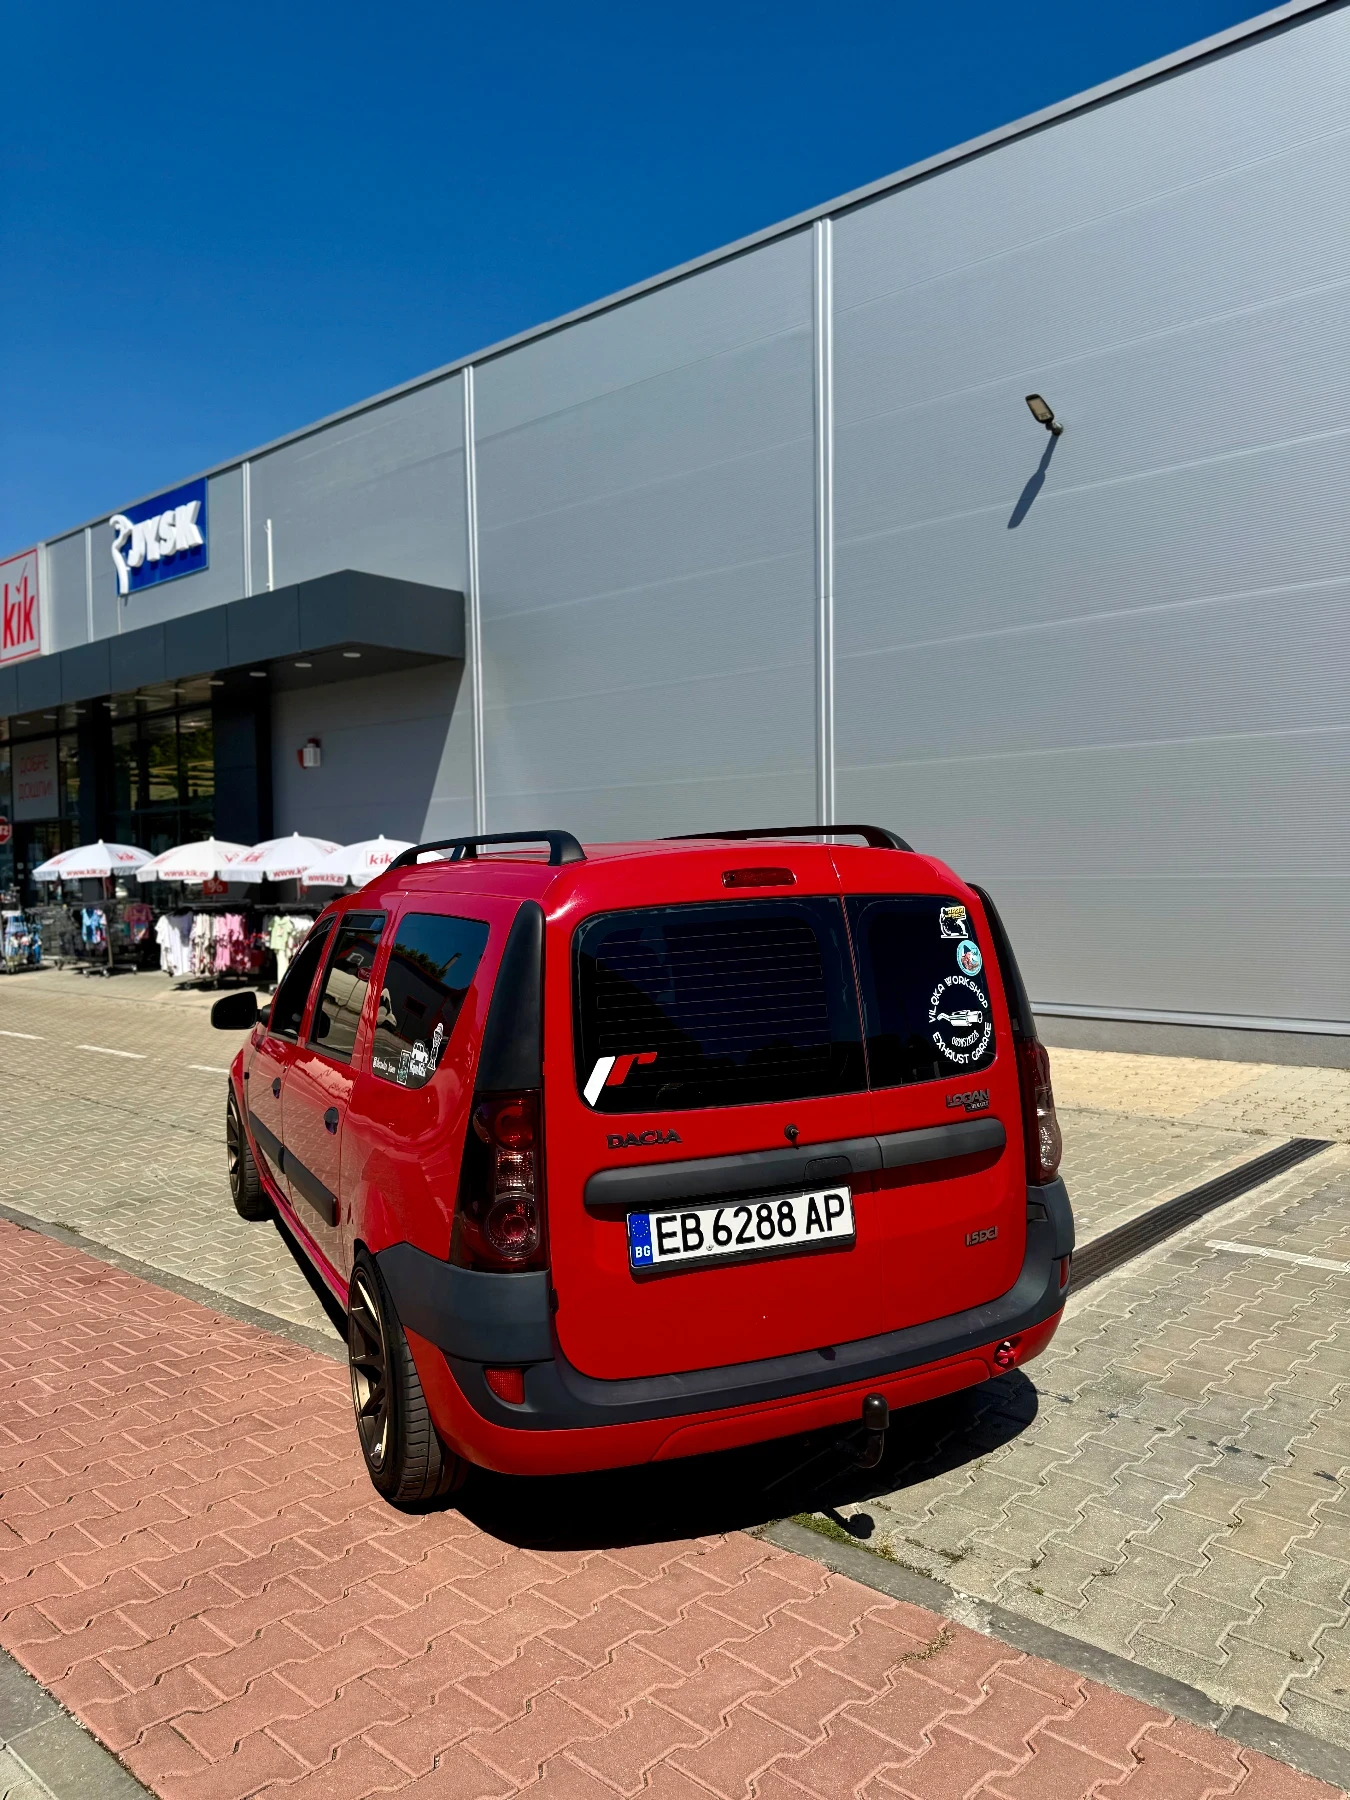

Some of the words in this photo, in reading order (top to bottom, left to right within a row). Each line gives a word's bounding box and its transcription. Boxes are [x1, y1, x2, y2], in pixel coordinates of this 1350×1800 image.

[127, 500, 204, 568] JYSK
[3, 576, 35, 649] kik
[369, 853, 393, 865] kik
[66, 867, 108, 877] www.kik.eu
[163, 869, 209, 878] www.kik.eu
[944, 975, 989, 1009] WORKSHOP
[932, 1031, 970, 1064] EXHAUST
[971, 1021, 992, 1061] GARAGE
[946, 1088, 990, 1108] LOGAN
[606, 1128, 682, 1149] DACIA
[656, 1212, 704, 1257] EB
[712, 1200, 797, 1247] 6288
[805, 1193, 845, 1235] AP
[635, 1245, 651, 1259] BG
